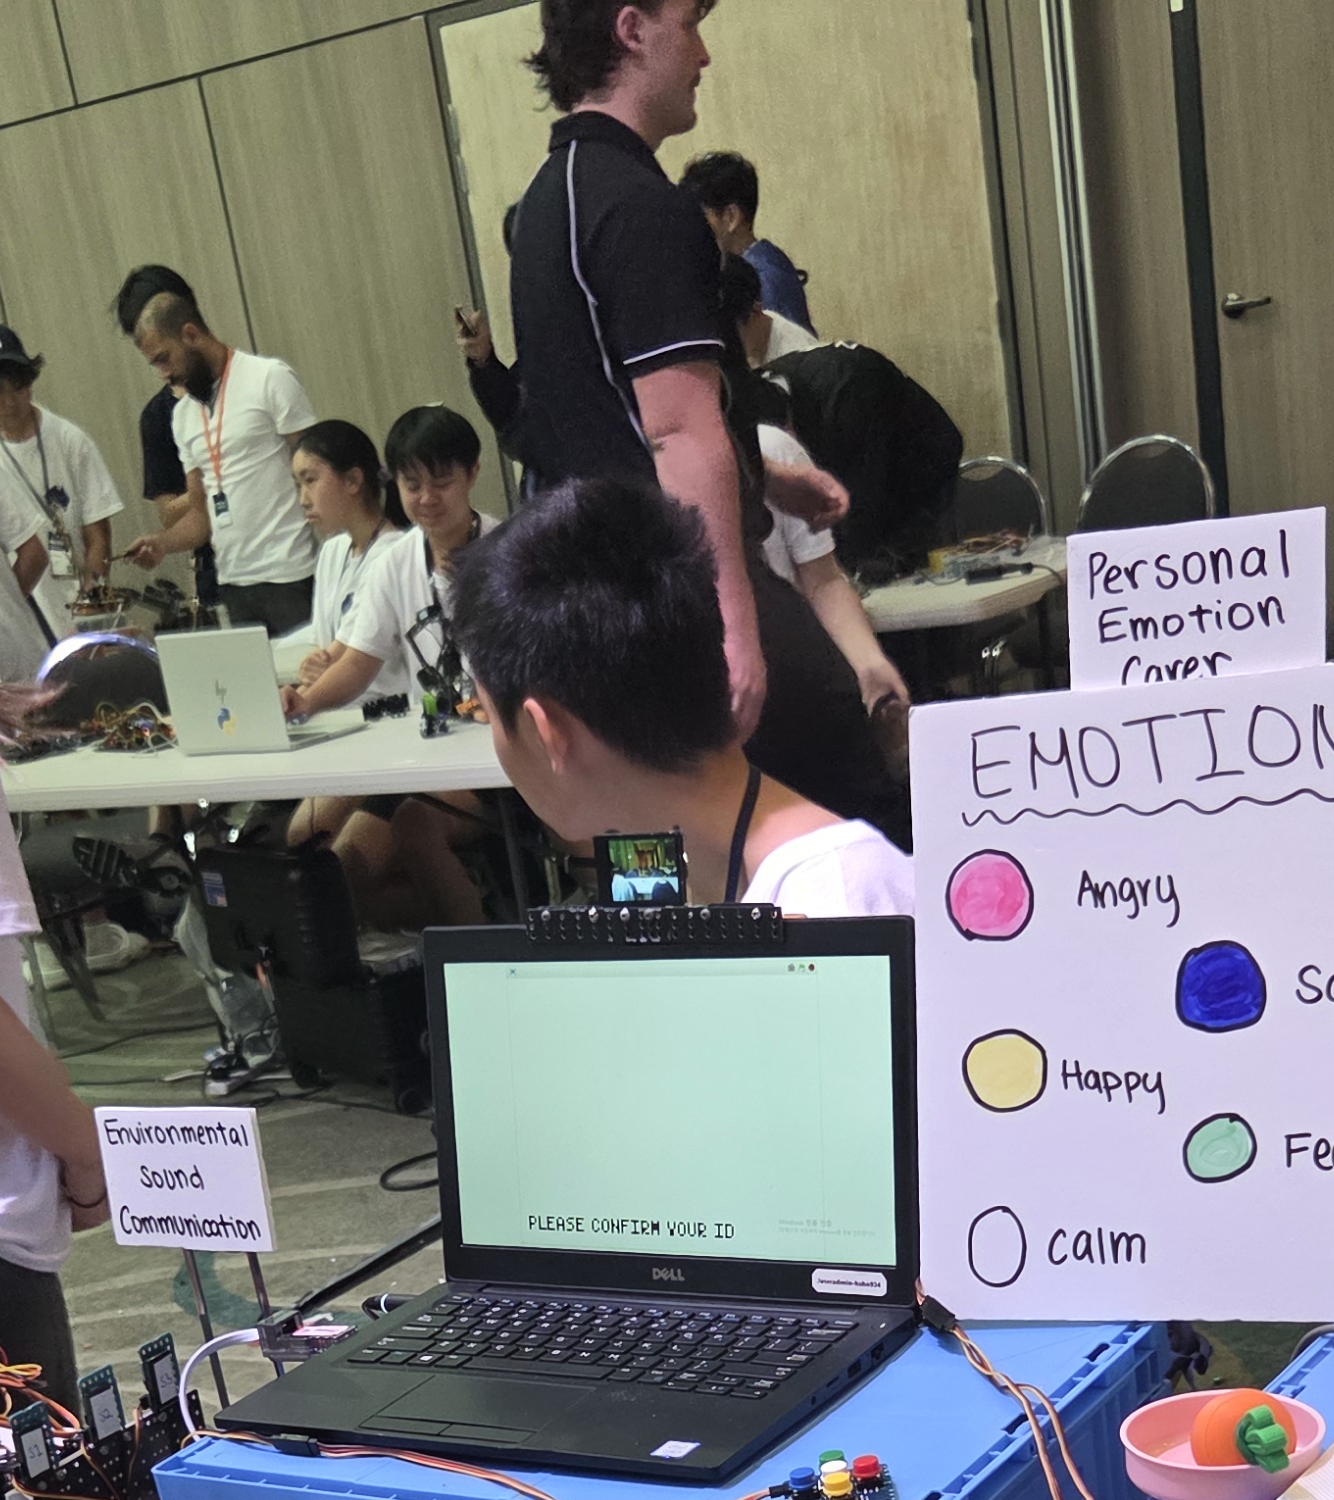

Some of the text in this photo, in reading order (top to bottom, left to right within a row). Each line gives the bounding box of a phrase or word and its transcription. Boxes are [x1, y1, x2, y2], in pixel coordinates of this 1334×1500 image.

[1088, 529, 1290, 600] Personal
[1099, 594, 1286, 644] Emotion
[1078, 869, 1180, 927] Angry
[1060, 1060, 1166, 1114] Happy
[104, 1118, 249, 1147] Environmental
[140, 1165, 204, 1190] Sound
[119, 1205, 262, 1241] Communication
[528, 1215, 735, 1240] PLEASE CONFIRM YOUR ID
[652, 1267, 686, 1282] DELL
